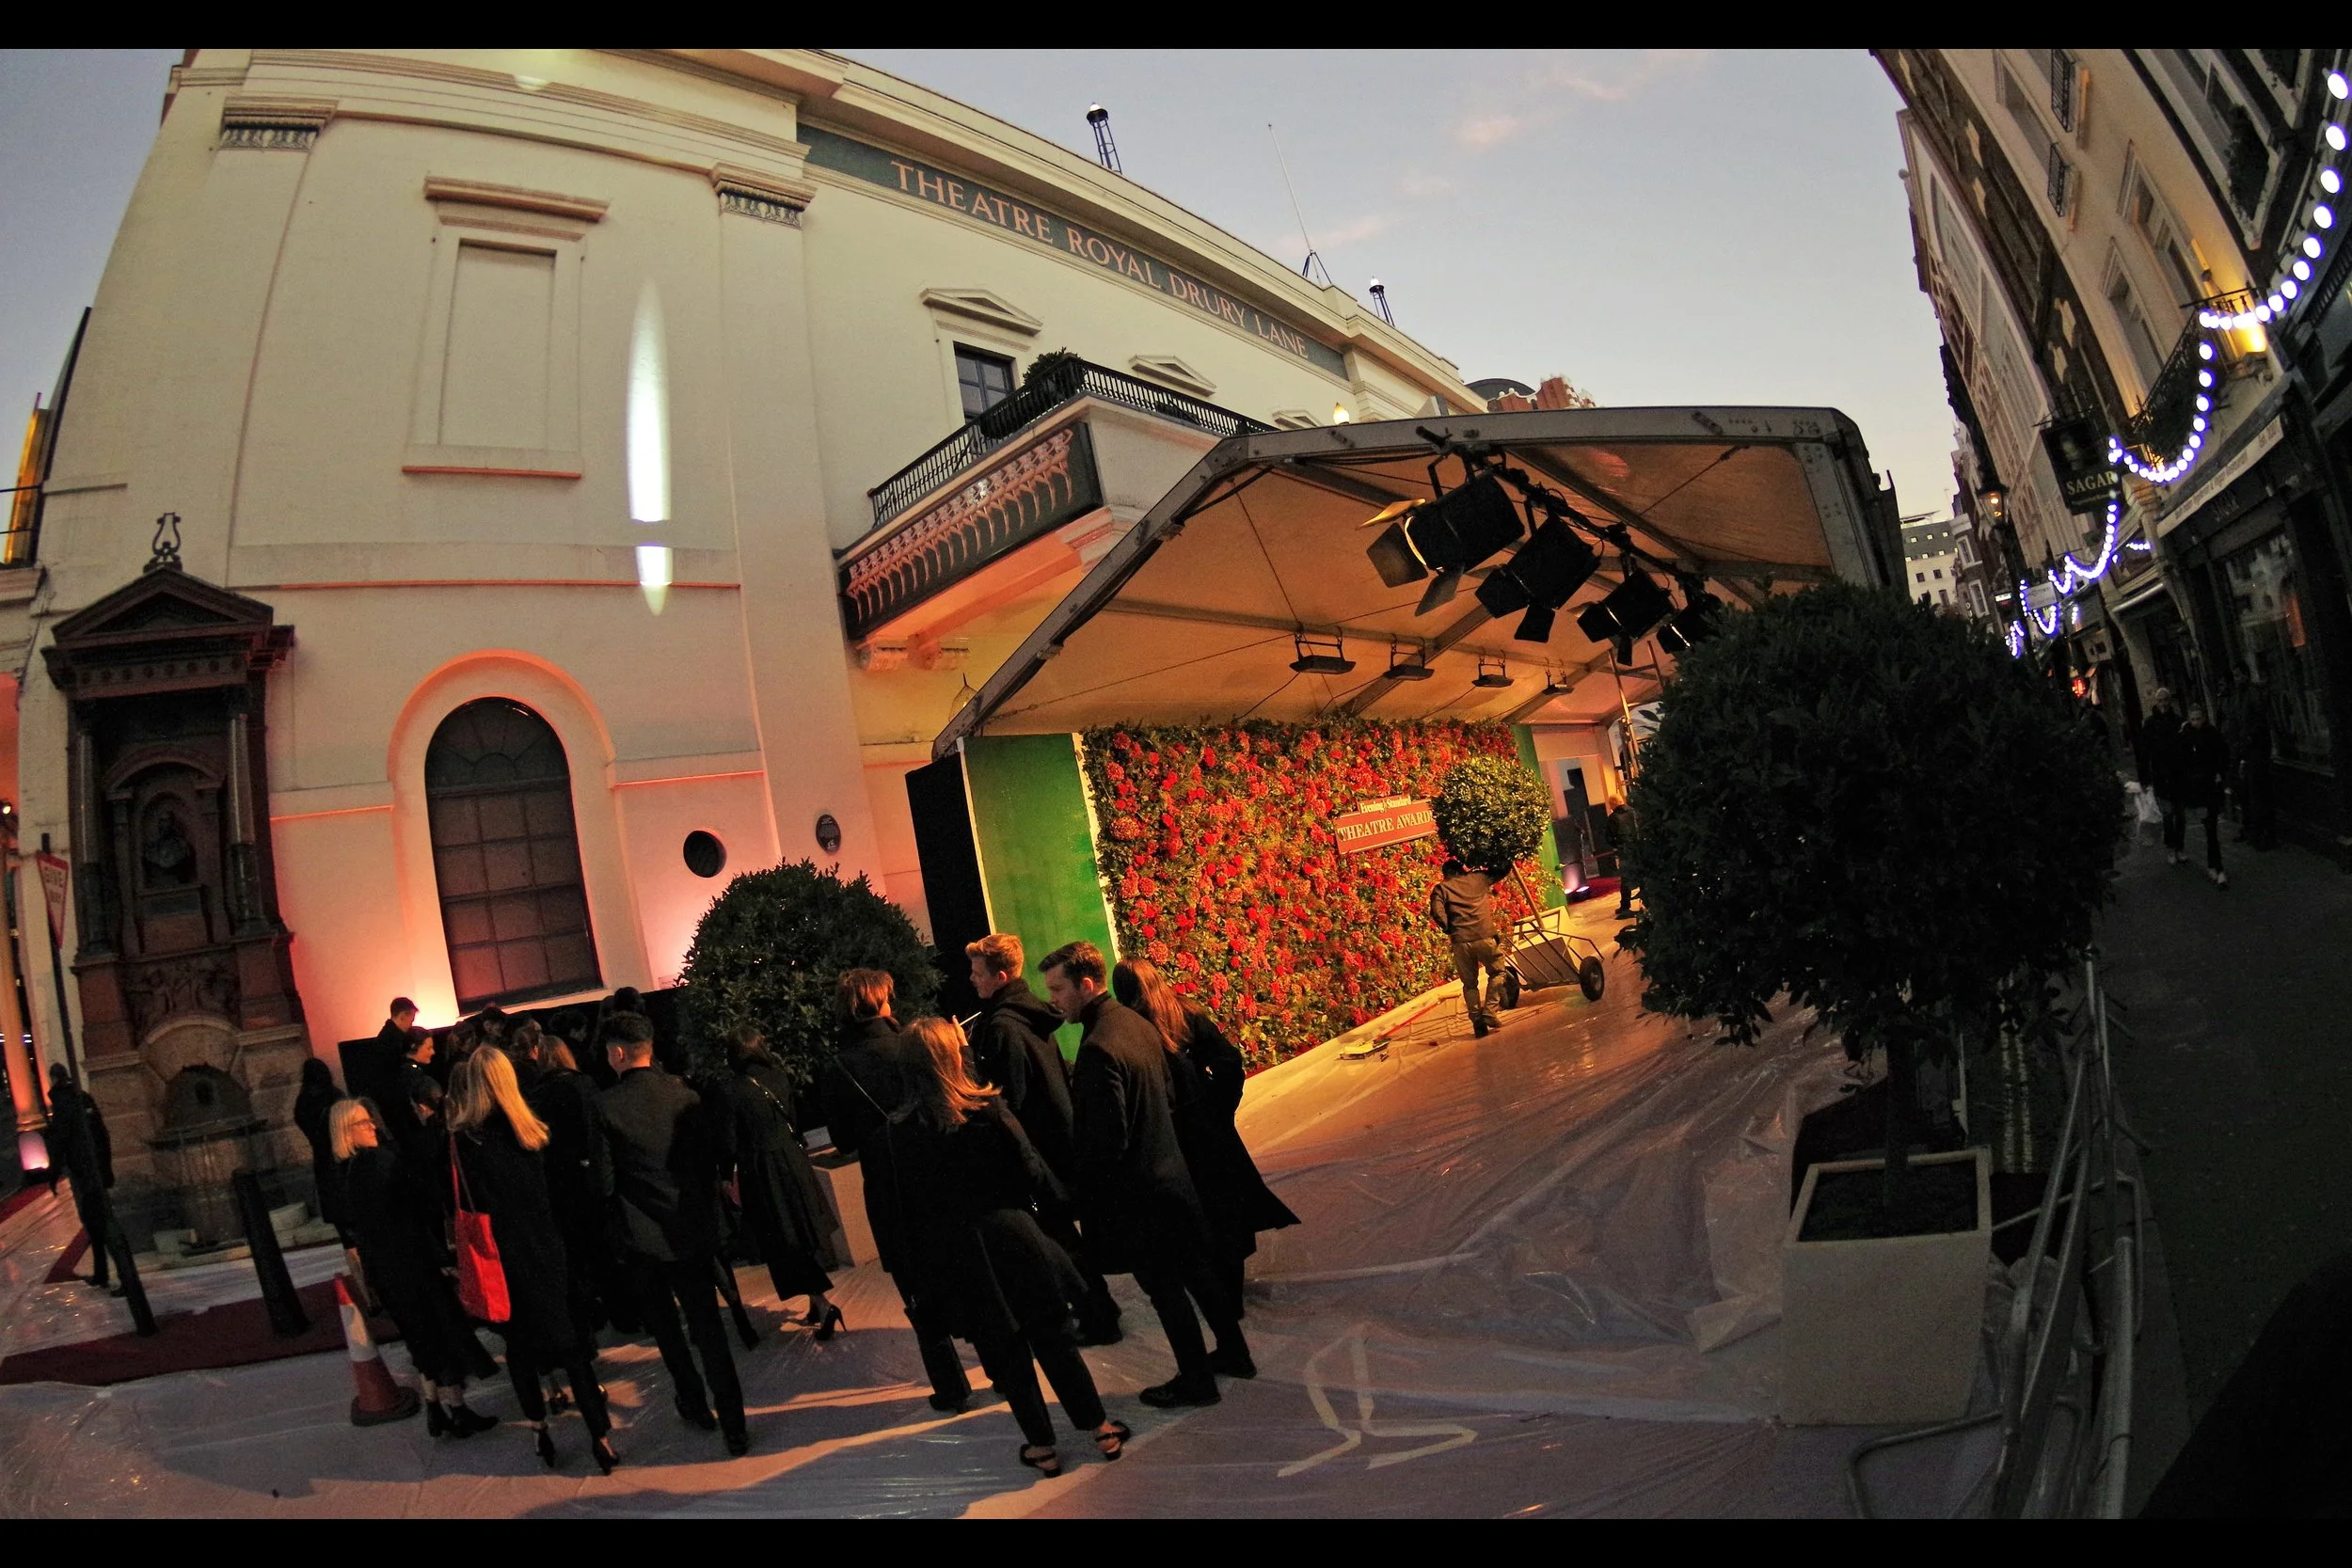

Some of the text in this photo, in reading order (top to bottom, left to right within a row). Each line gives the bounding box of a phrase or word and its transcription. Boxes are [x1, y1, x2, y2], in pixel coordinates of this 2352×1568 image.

[890, 160, 1309, 358] THEATRE ROYAL DRURY LANE
[2066, 471, 2118, 495] SAGAR
[1360, 796, 1412, 814] Evening Standard
[1337, 817, 1395, 842] THEATRE
